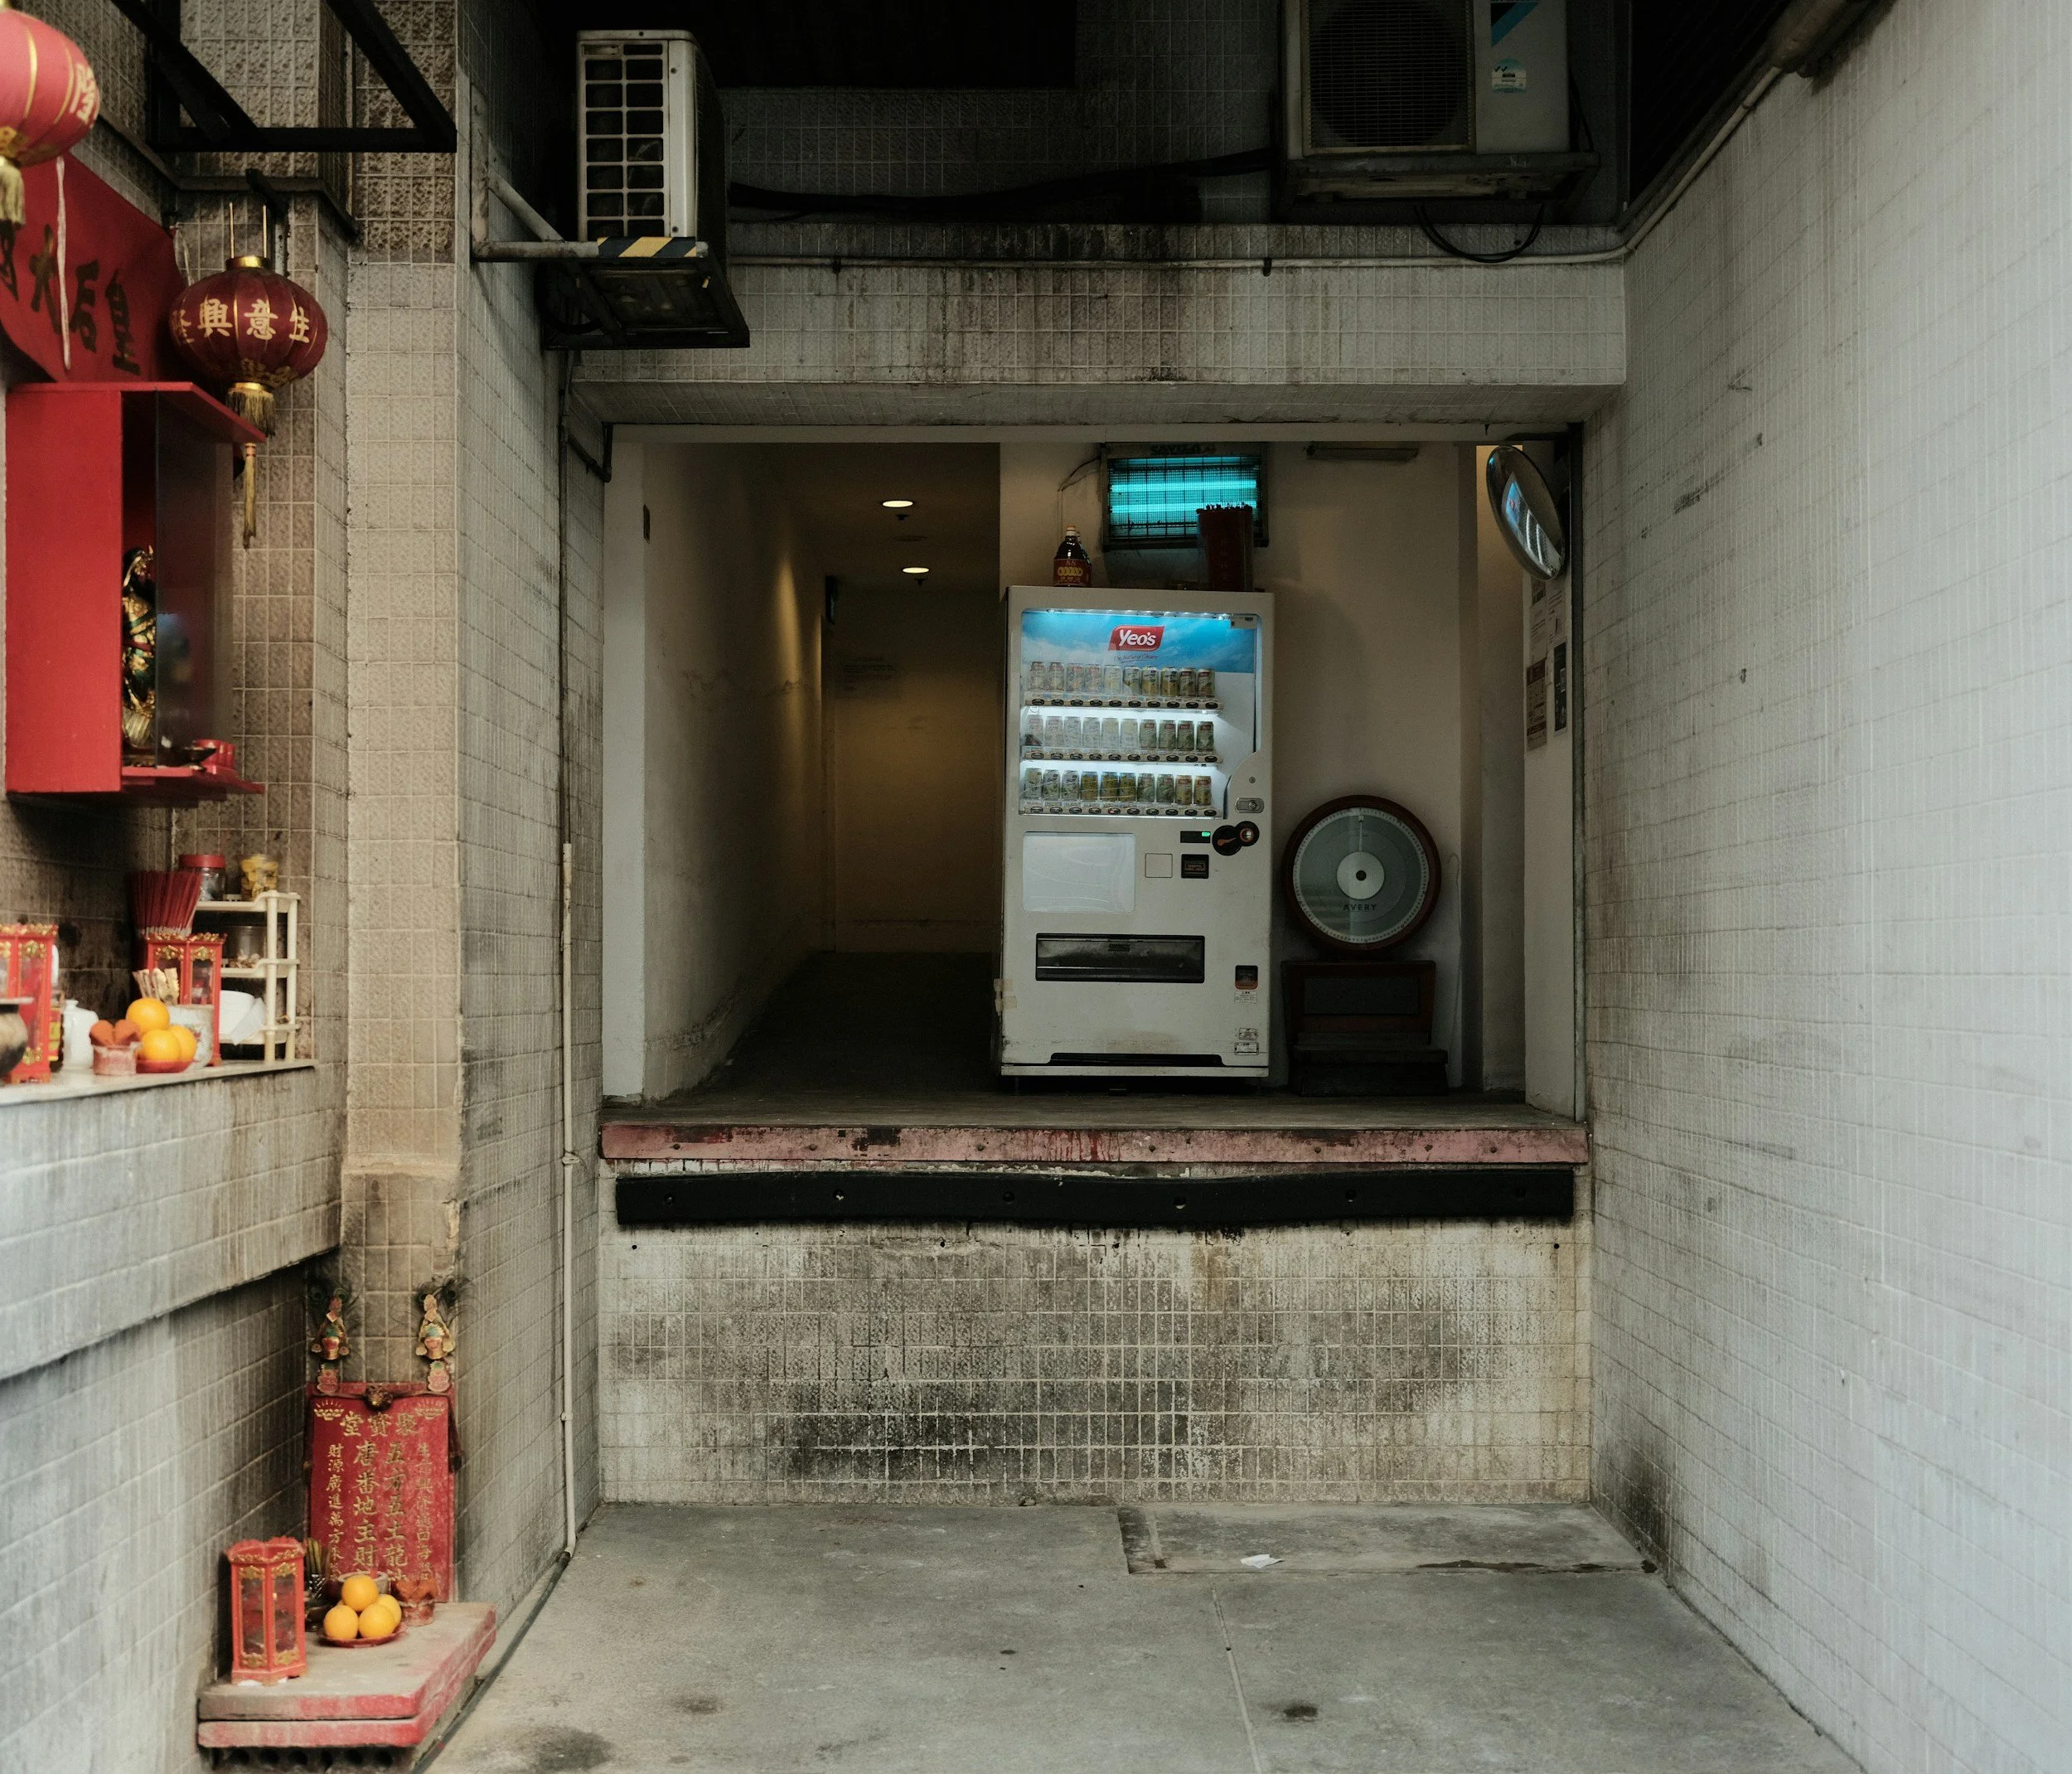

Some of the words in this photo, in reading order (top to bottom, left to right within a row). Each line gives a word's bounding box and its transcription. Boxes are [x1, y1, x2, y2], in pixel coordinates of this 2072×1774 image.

[1119, 629, 1156, 647] Yeo's
[351, 1440, 379, 1574] 唐番地主財
